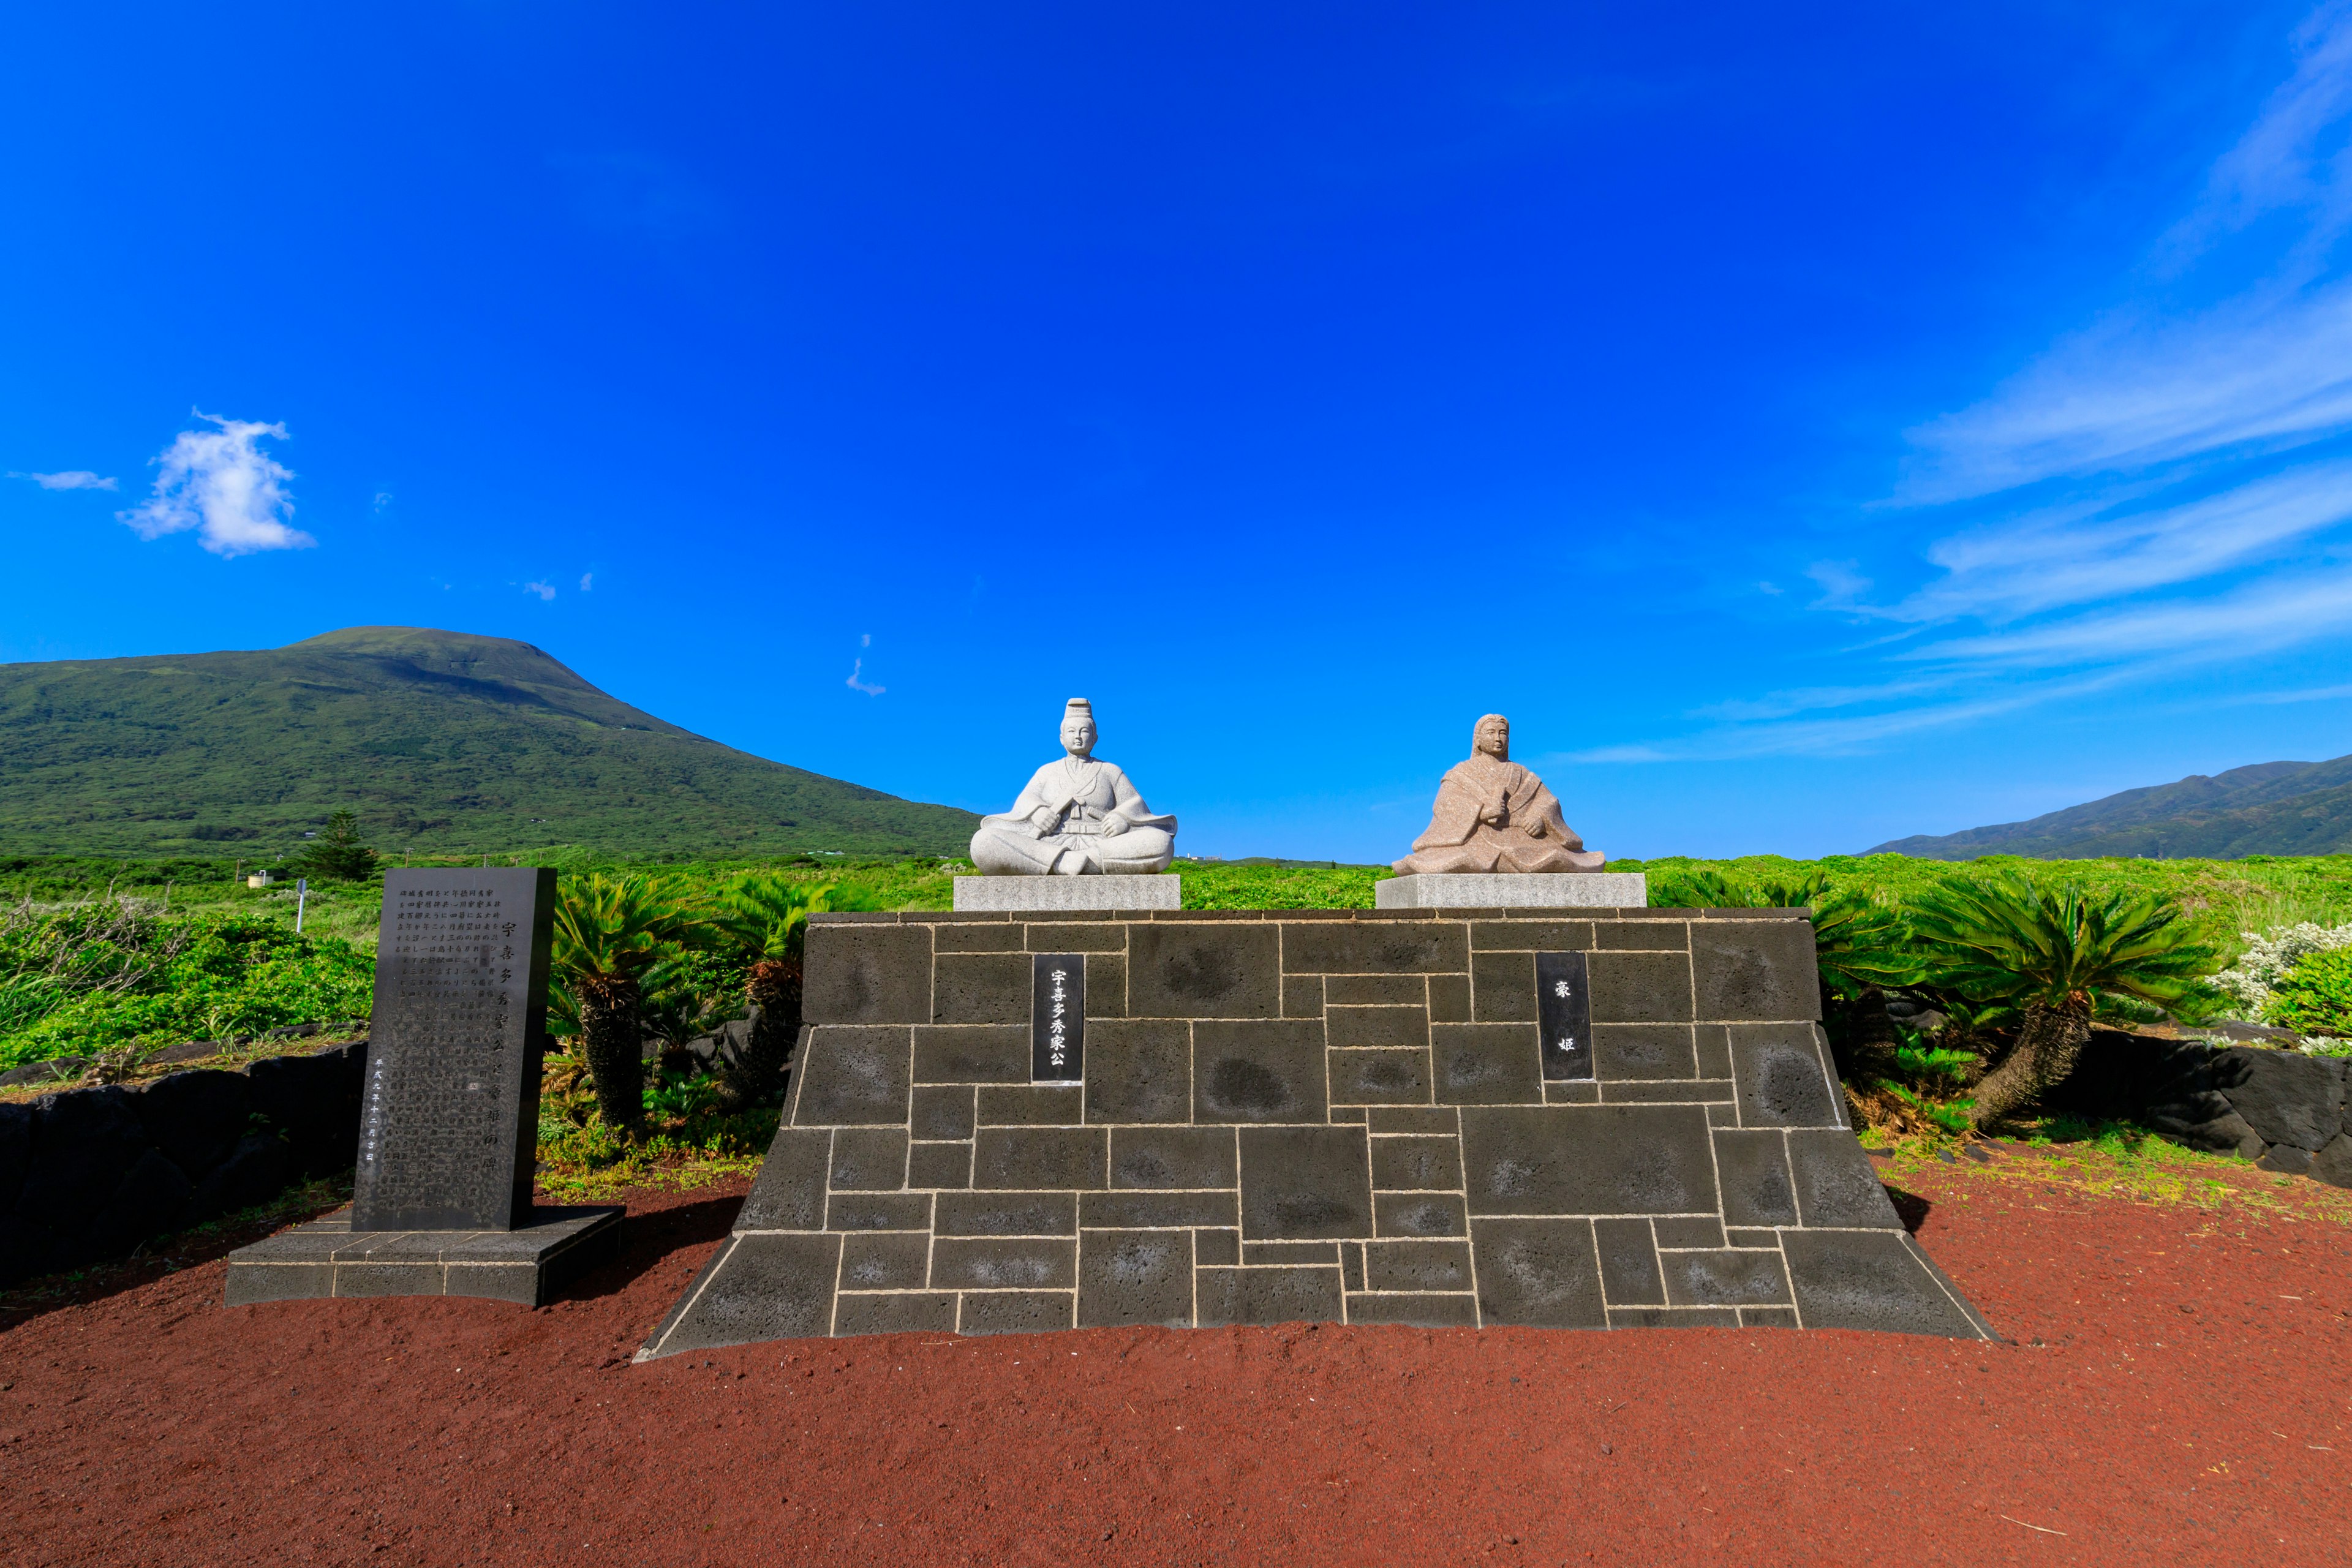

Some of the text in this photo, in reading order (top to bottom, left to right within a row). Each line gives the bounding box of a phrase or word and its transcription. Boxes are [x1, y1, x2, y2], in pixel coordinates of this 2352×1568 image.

[482, 922, 516, 1171] 宇喜多秀家公と豪姫の碑
[1050, 970, 1066, 1066] 宇喜多秀家公
[1555, 981, 1575, 1051] 豪姫
[366, 1058, 383, 1161] 平成九年十二月吉日
